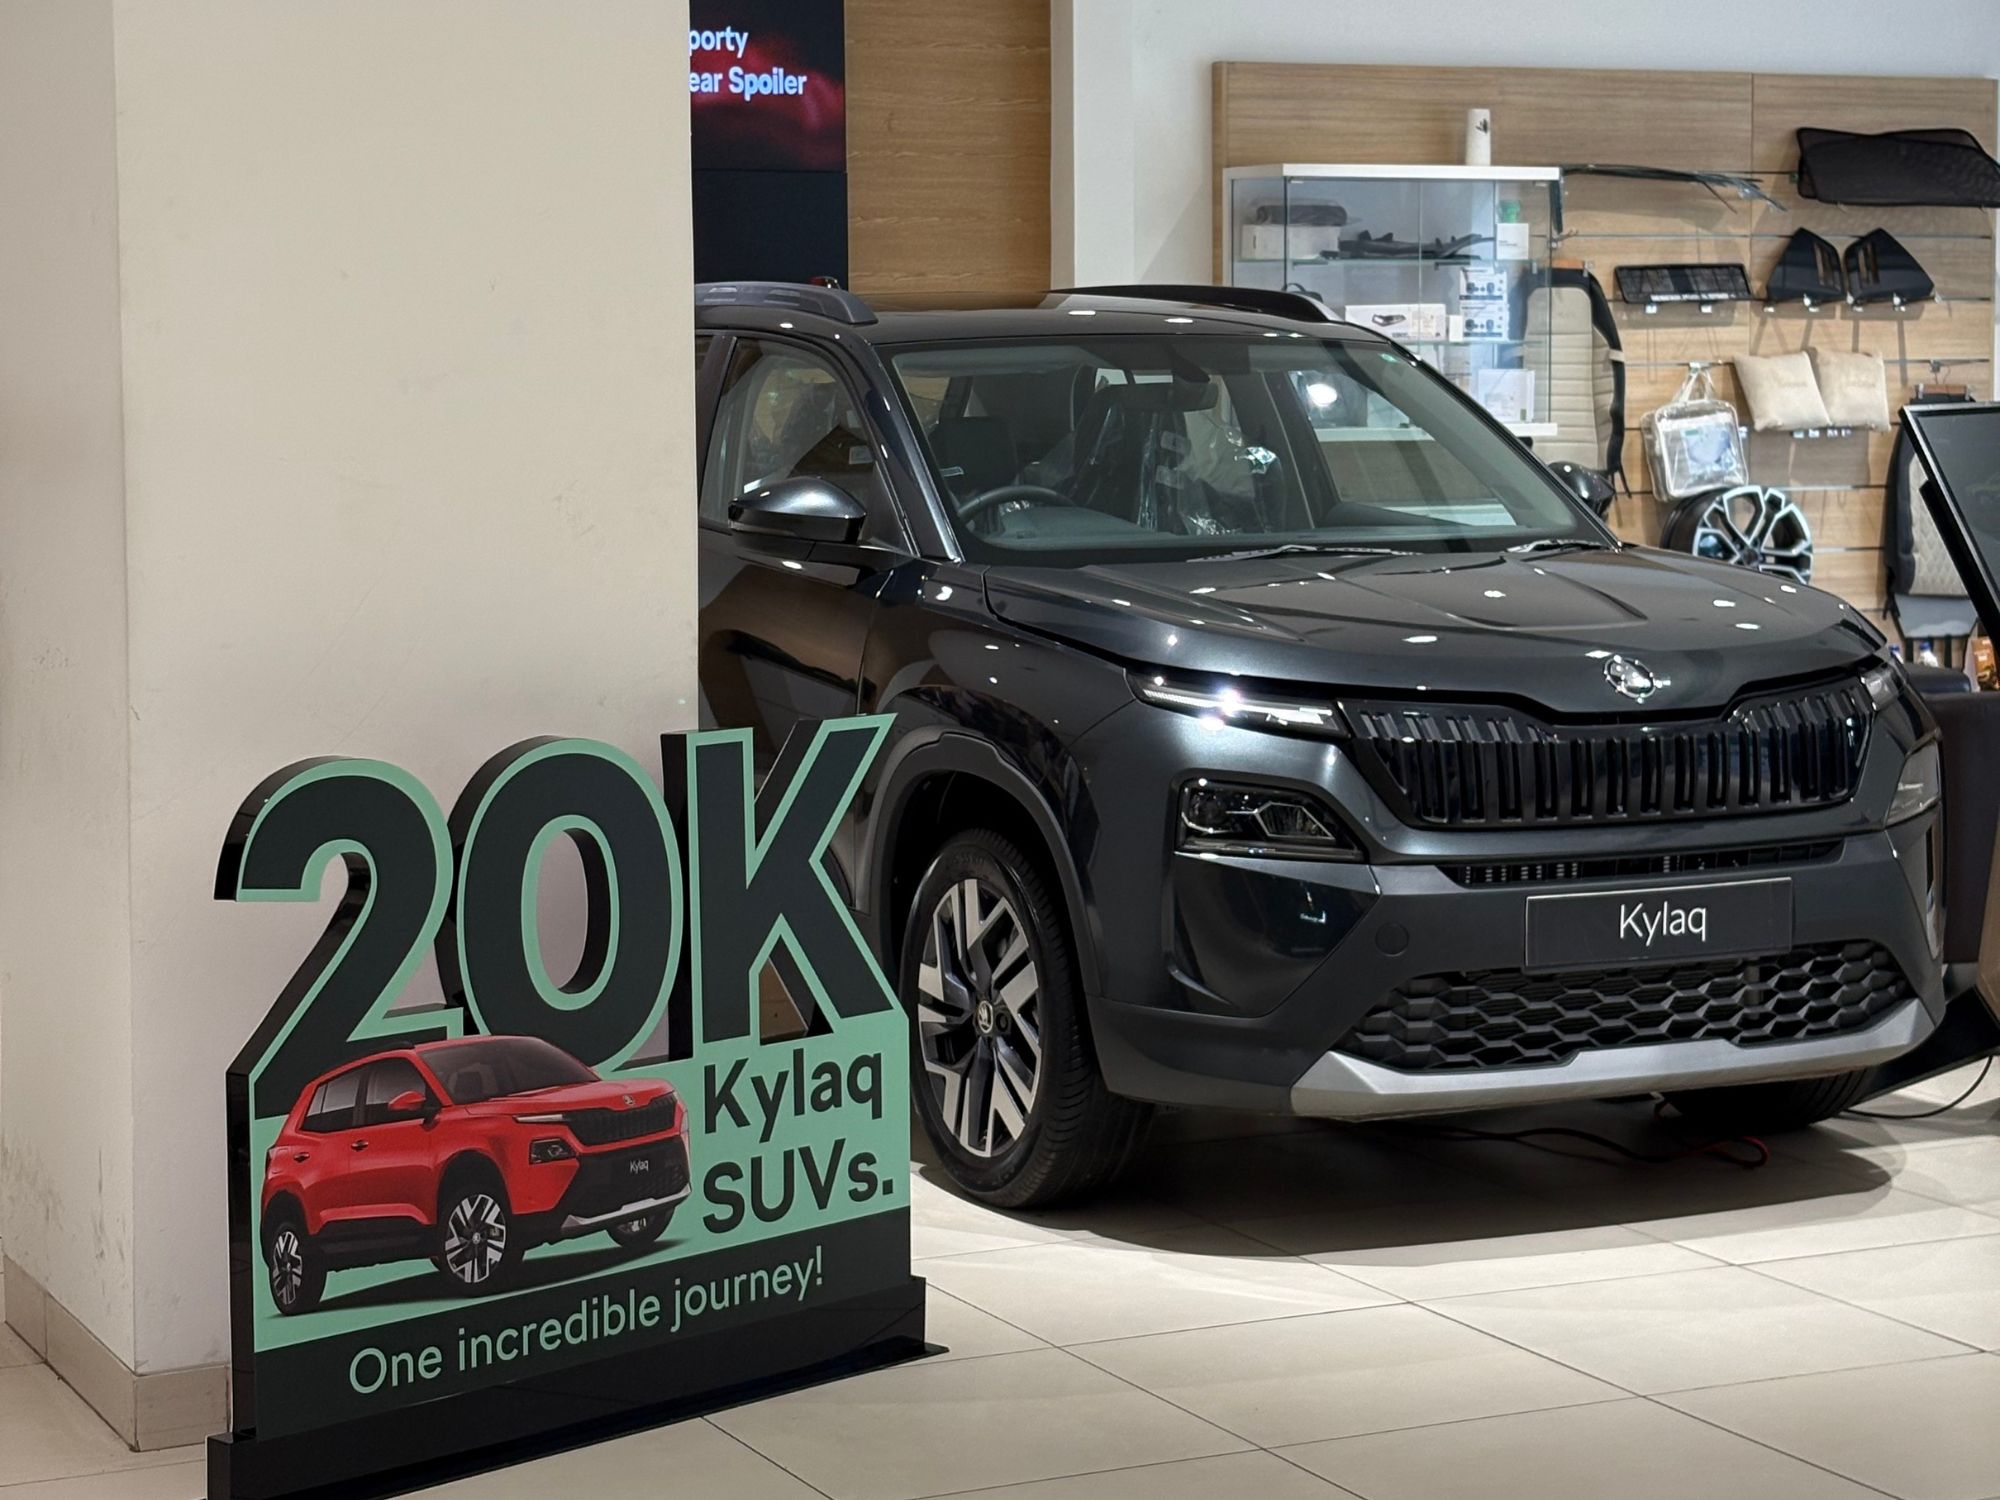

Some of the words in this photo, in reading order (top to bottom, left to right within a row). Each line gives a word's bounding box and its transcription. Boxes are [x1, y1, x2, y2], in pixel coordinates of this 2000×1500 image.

[728, 66, 808, 102] Spoiler
[237, 714, 900, 1118] 20K
[1619, 900, 1707, 946] Kylaq
[703, 1048, 883, 1144] Kylaq
[702, 1138, 894, 1234] SUVs.
[349, 1346, 443, 1395] One
[458, 1288, 661, 1372] incredible
[670, 1245, 823, 1333] journey!
